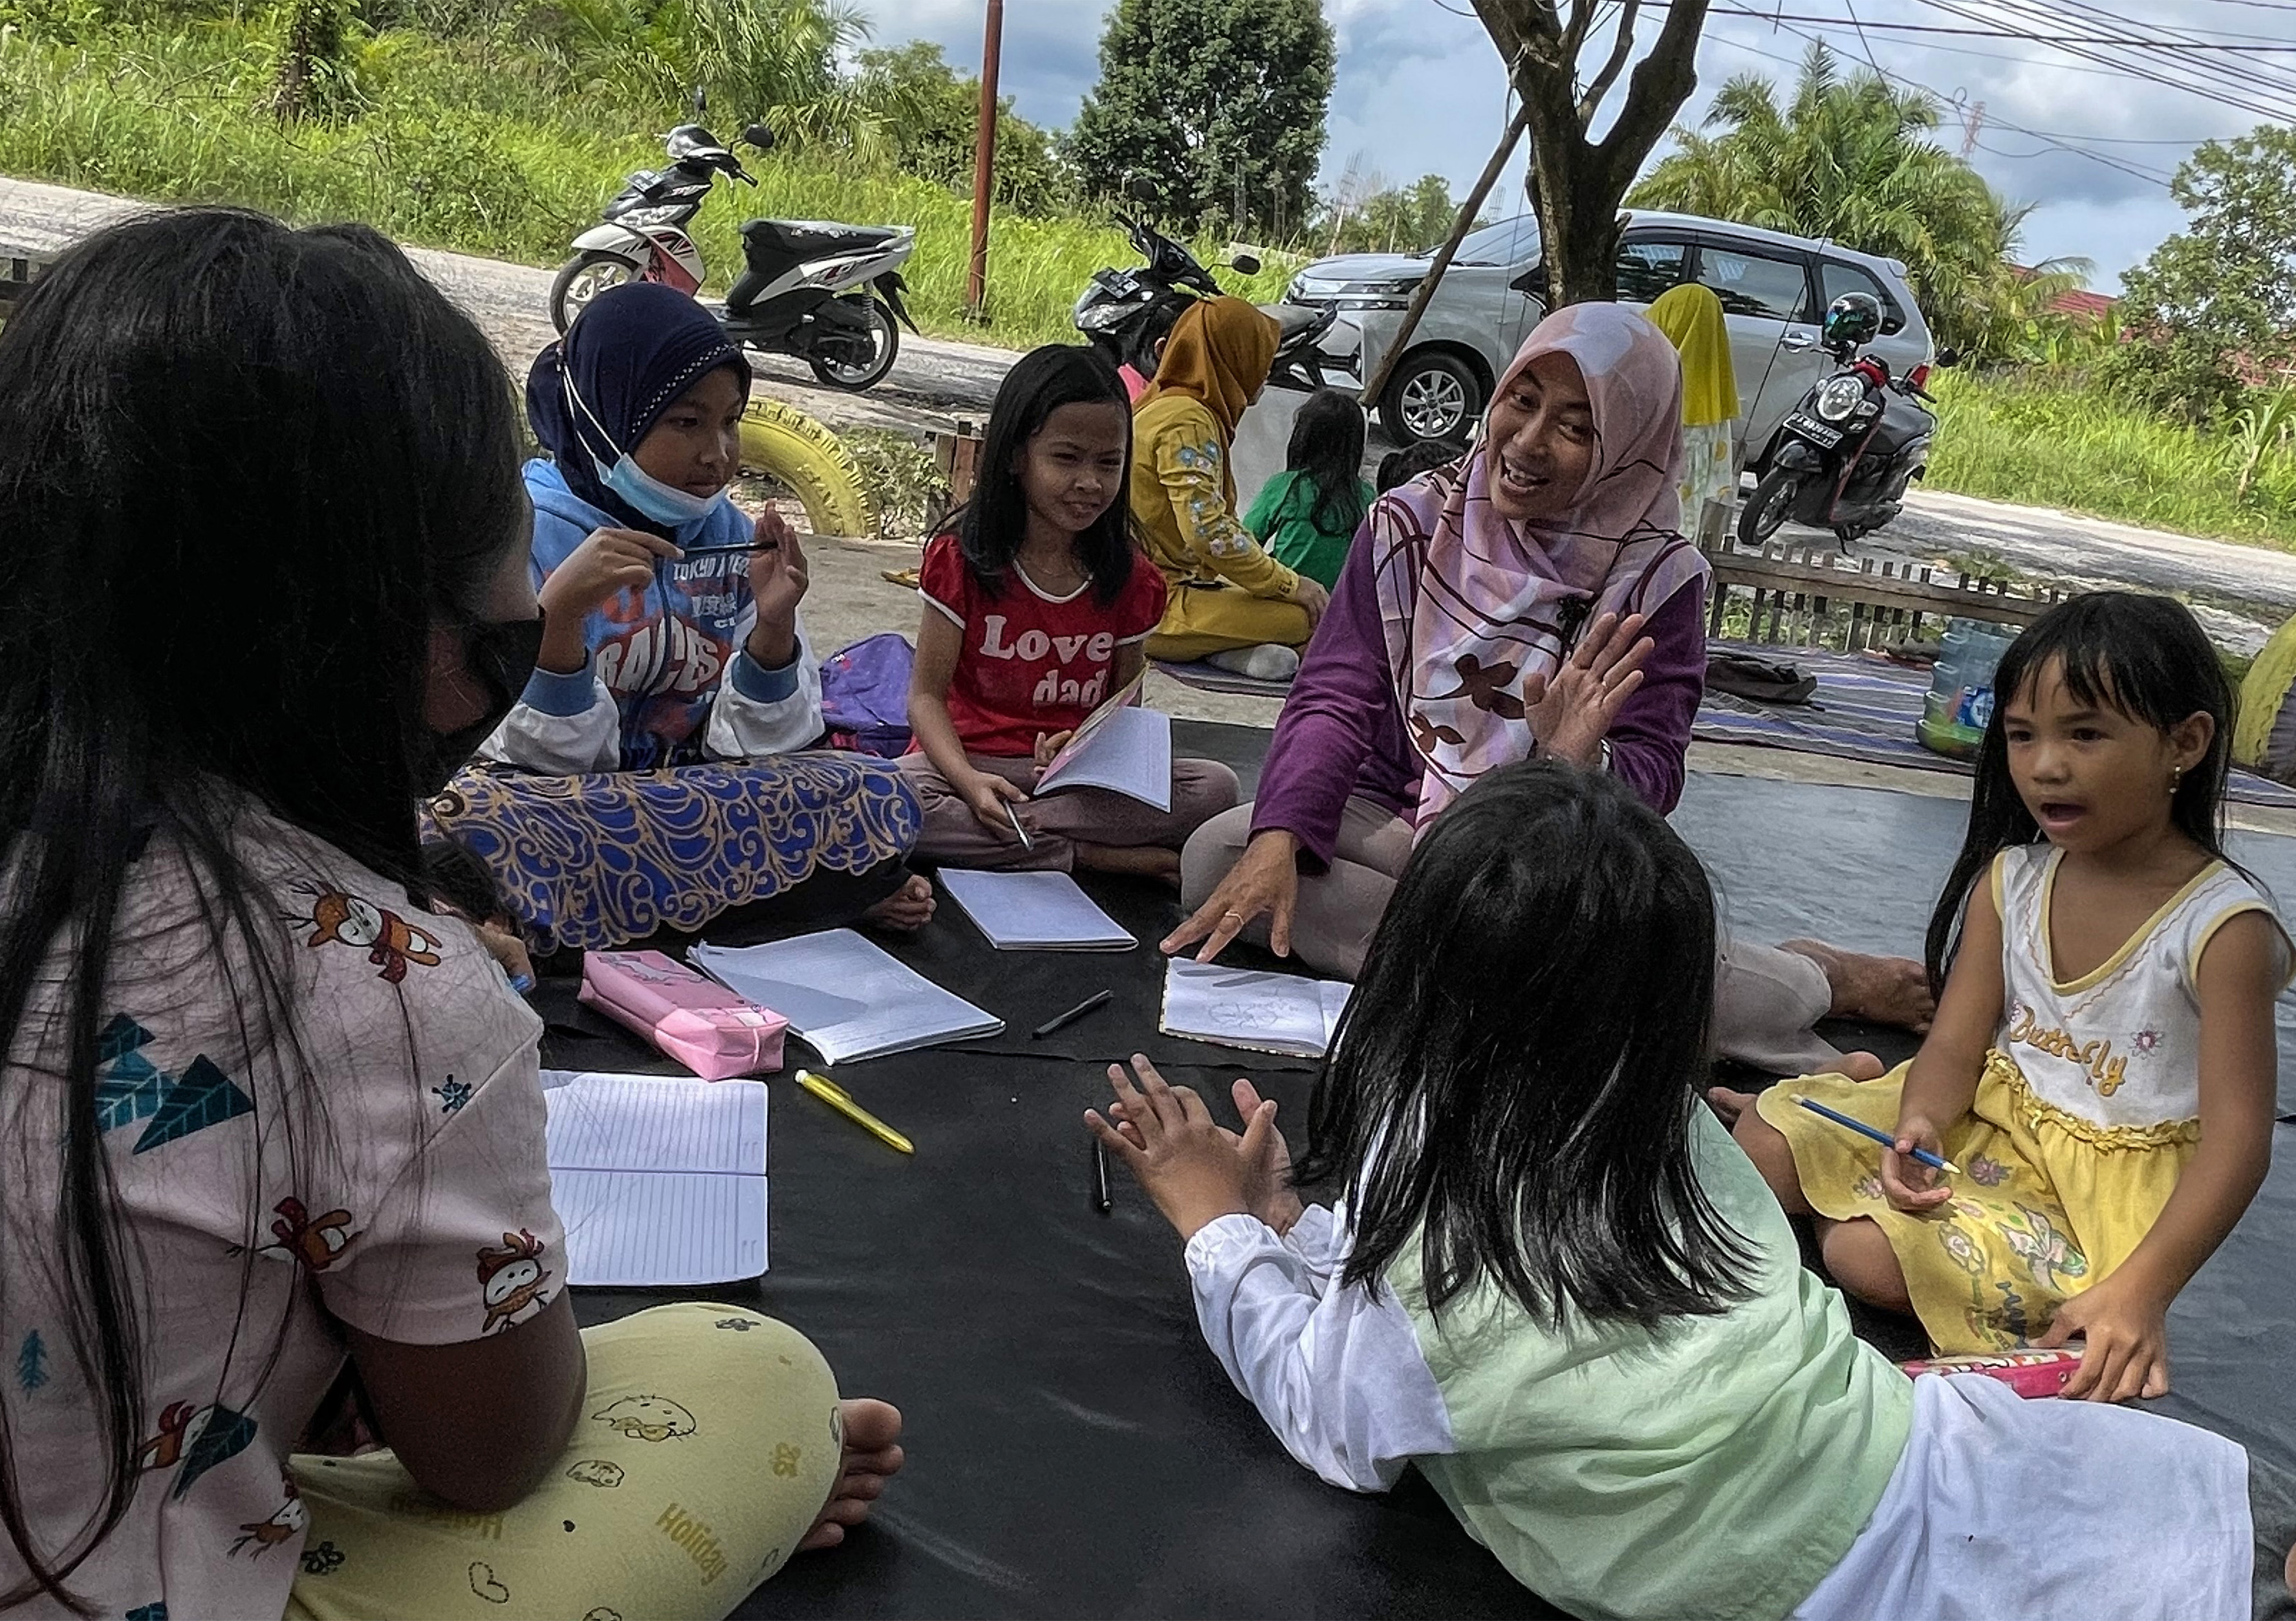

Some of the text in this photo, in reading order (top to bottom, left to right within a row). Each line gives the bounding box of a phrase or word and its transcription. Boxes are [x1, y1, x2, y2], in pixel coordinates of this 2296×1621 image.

[979, 615, 1114, 665] Love
[1032, 668, 1108, 709] dad
[655, 1502, 729, 1587] Holiday
